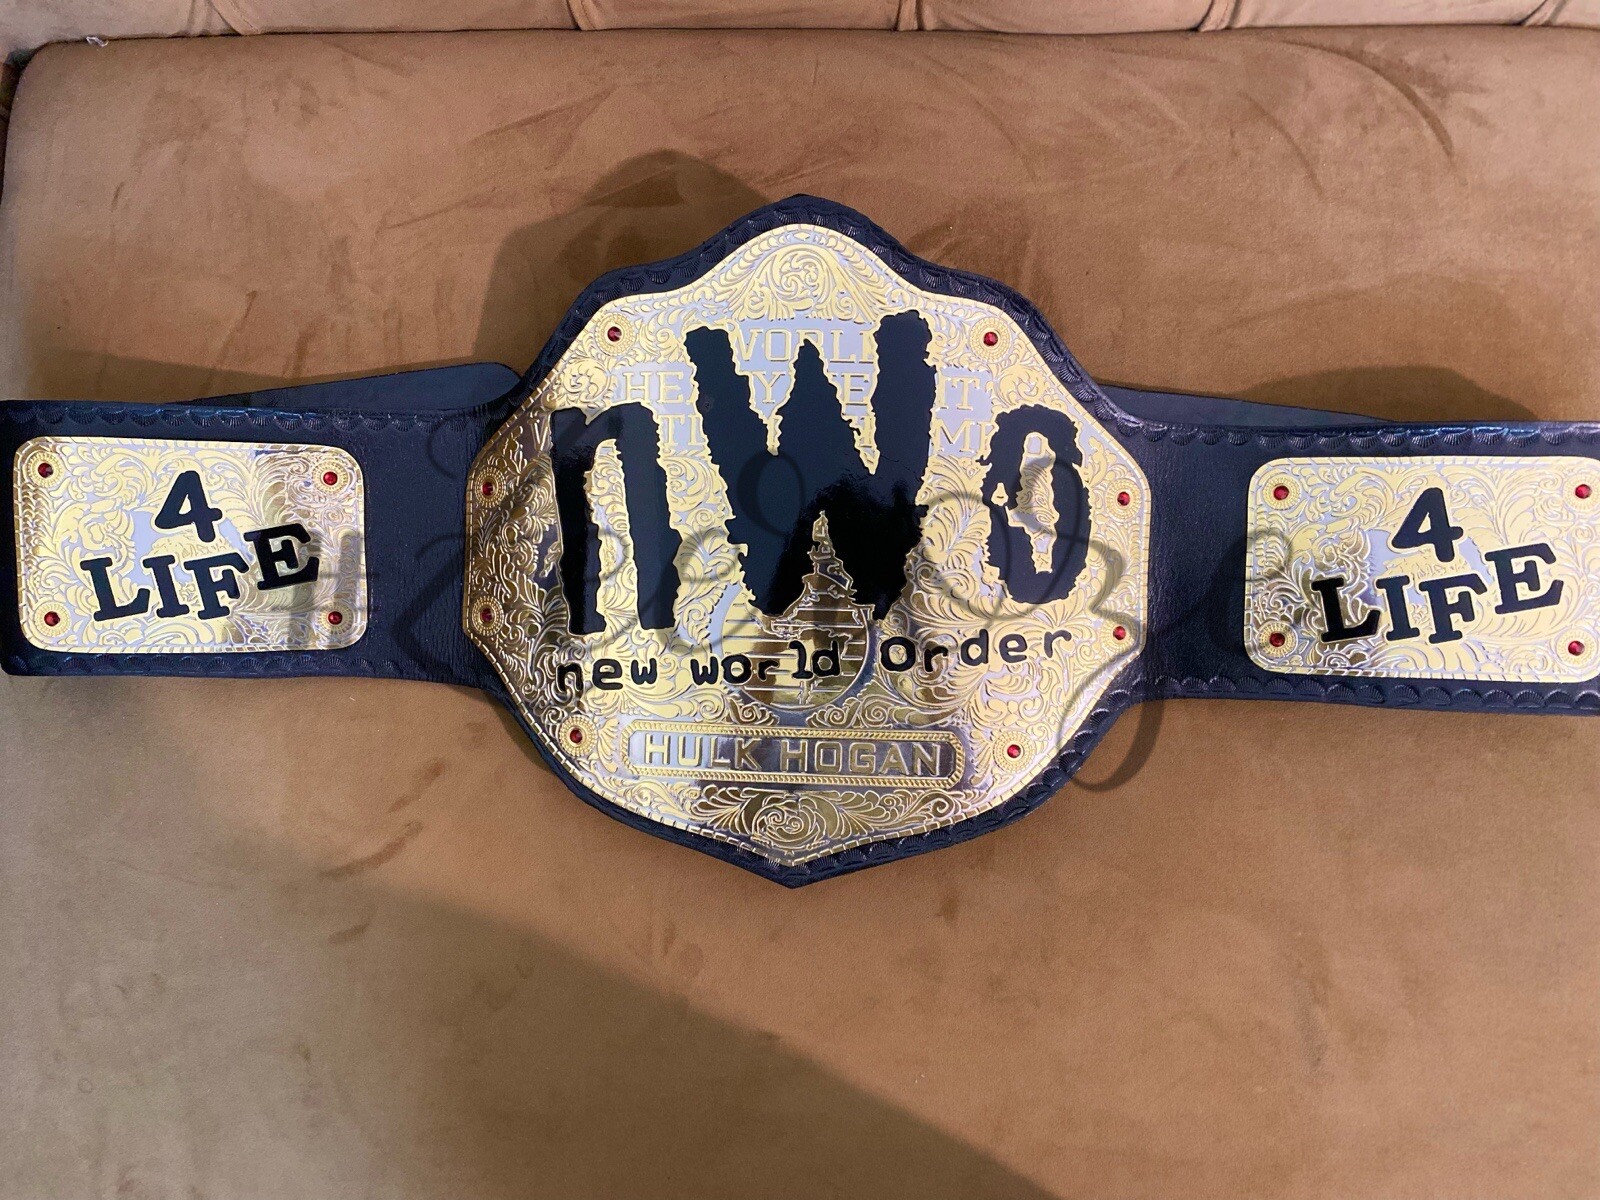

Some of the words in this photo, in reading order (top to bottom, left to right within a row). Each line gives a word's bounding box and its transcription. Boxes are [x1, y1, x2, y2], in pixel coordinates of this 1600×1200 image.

[155, 470, 223, 543] 4
[1391, 487, 1464, 563] 4
[80, 522, 320, 622] LIFE
[1311, 542, 1565, 644] LIFE
[556, 658, 657, 692] new
[690, 640, 841, 685] world
[644, 734, 763, 772] HULK
[779, 738, 941, 777] HOGAN
